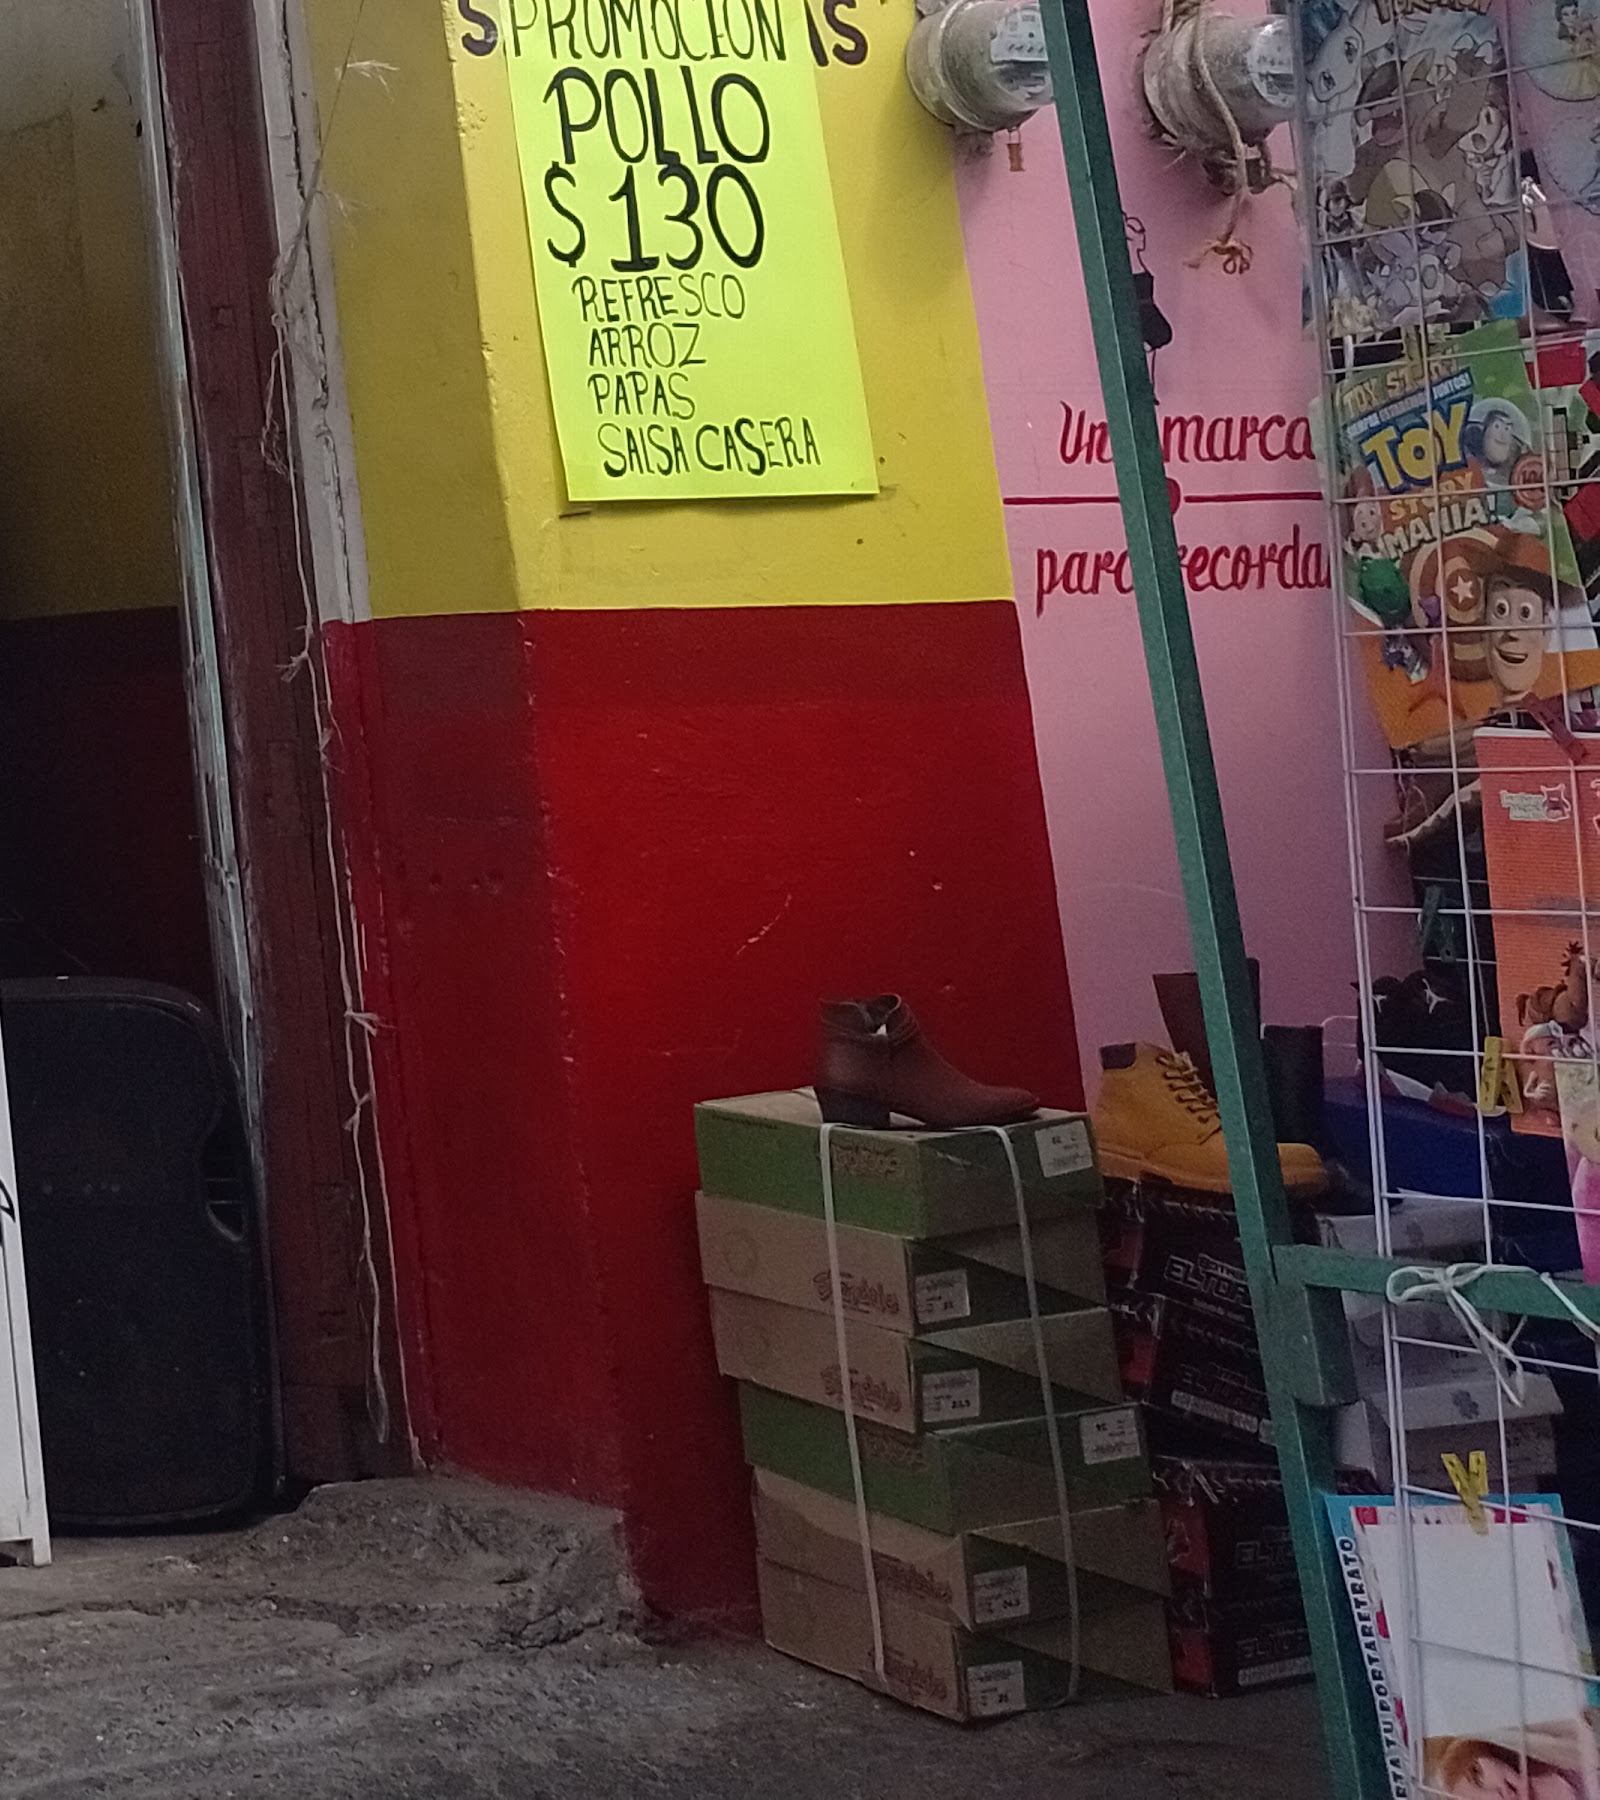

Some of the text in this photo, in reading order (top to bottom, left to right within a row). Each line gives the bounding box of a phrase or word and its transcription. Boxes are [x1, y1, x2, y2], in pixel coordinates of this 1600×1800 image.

[543, 66, 771, 165] POLLO
[571, 273, 746, 324] REFRESCO
[588, 322, 707, 369] ARROZ
[587, 372, 696, 420] PAPAS
[597, 416, 822, 478] SALSA CASERA
[1059, 400, 1114, 465] Un
[1162, 413, 1316, 464] marca
[1360, 401, 1468, 491] TOY
